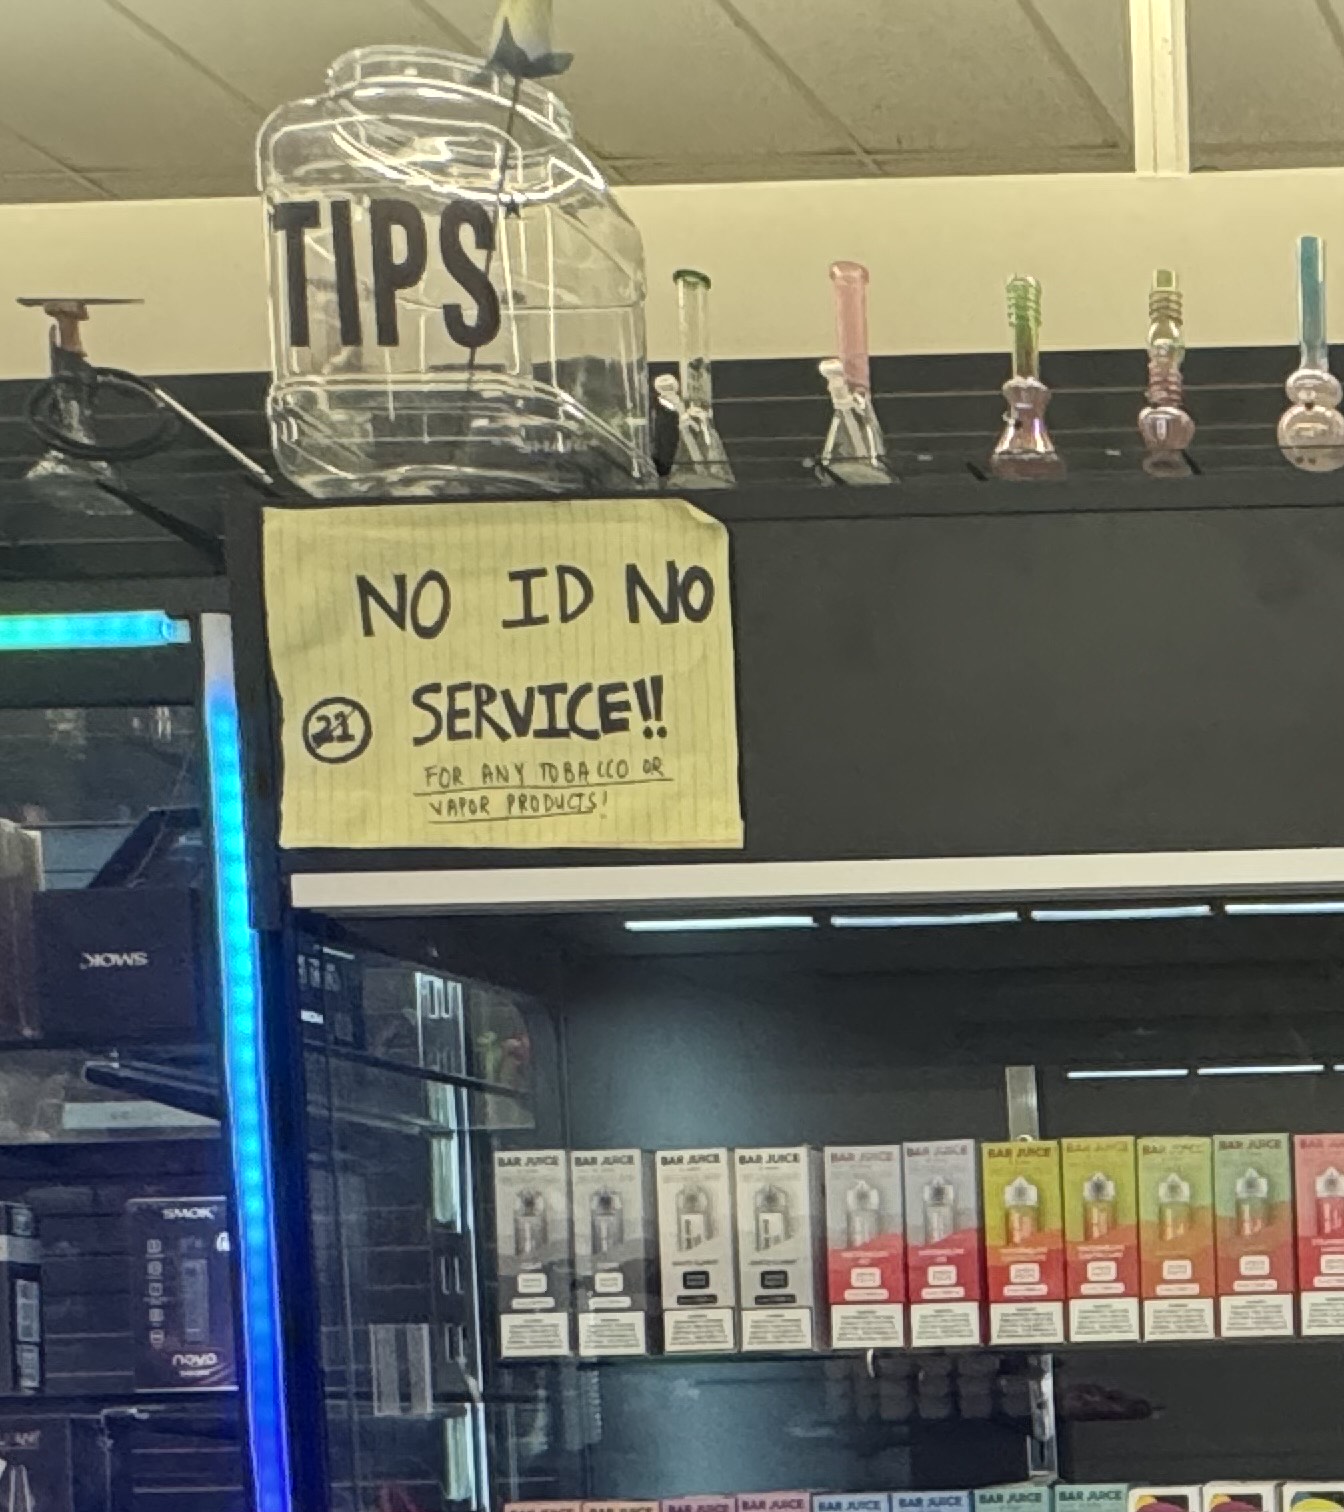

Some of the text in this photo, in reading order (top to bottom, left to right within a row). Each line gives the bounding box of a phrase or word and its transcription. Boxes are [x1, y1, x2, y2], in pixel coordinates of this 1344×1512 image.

[273, 200, 501, 350] TIPS
[356, 560, 715, 639] NO ID NO
[412, 675, 667, 746] SERVICE!!
[426, 756, 664, 786] FOR ANY TOBACCO OR
[429, 795, 490, 817] VAPOR
[497, 1155, 559, 1167] BAR JUICE
[574, 1155, 598, 1167] BAR
[660, 1153, 721, 1167] BAR JUICE
[738, 1153, 801, 1166] BAR JUICE
